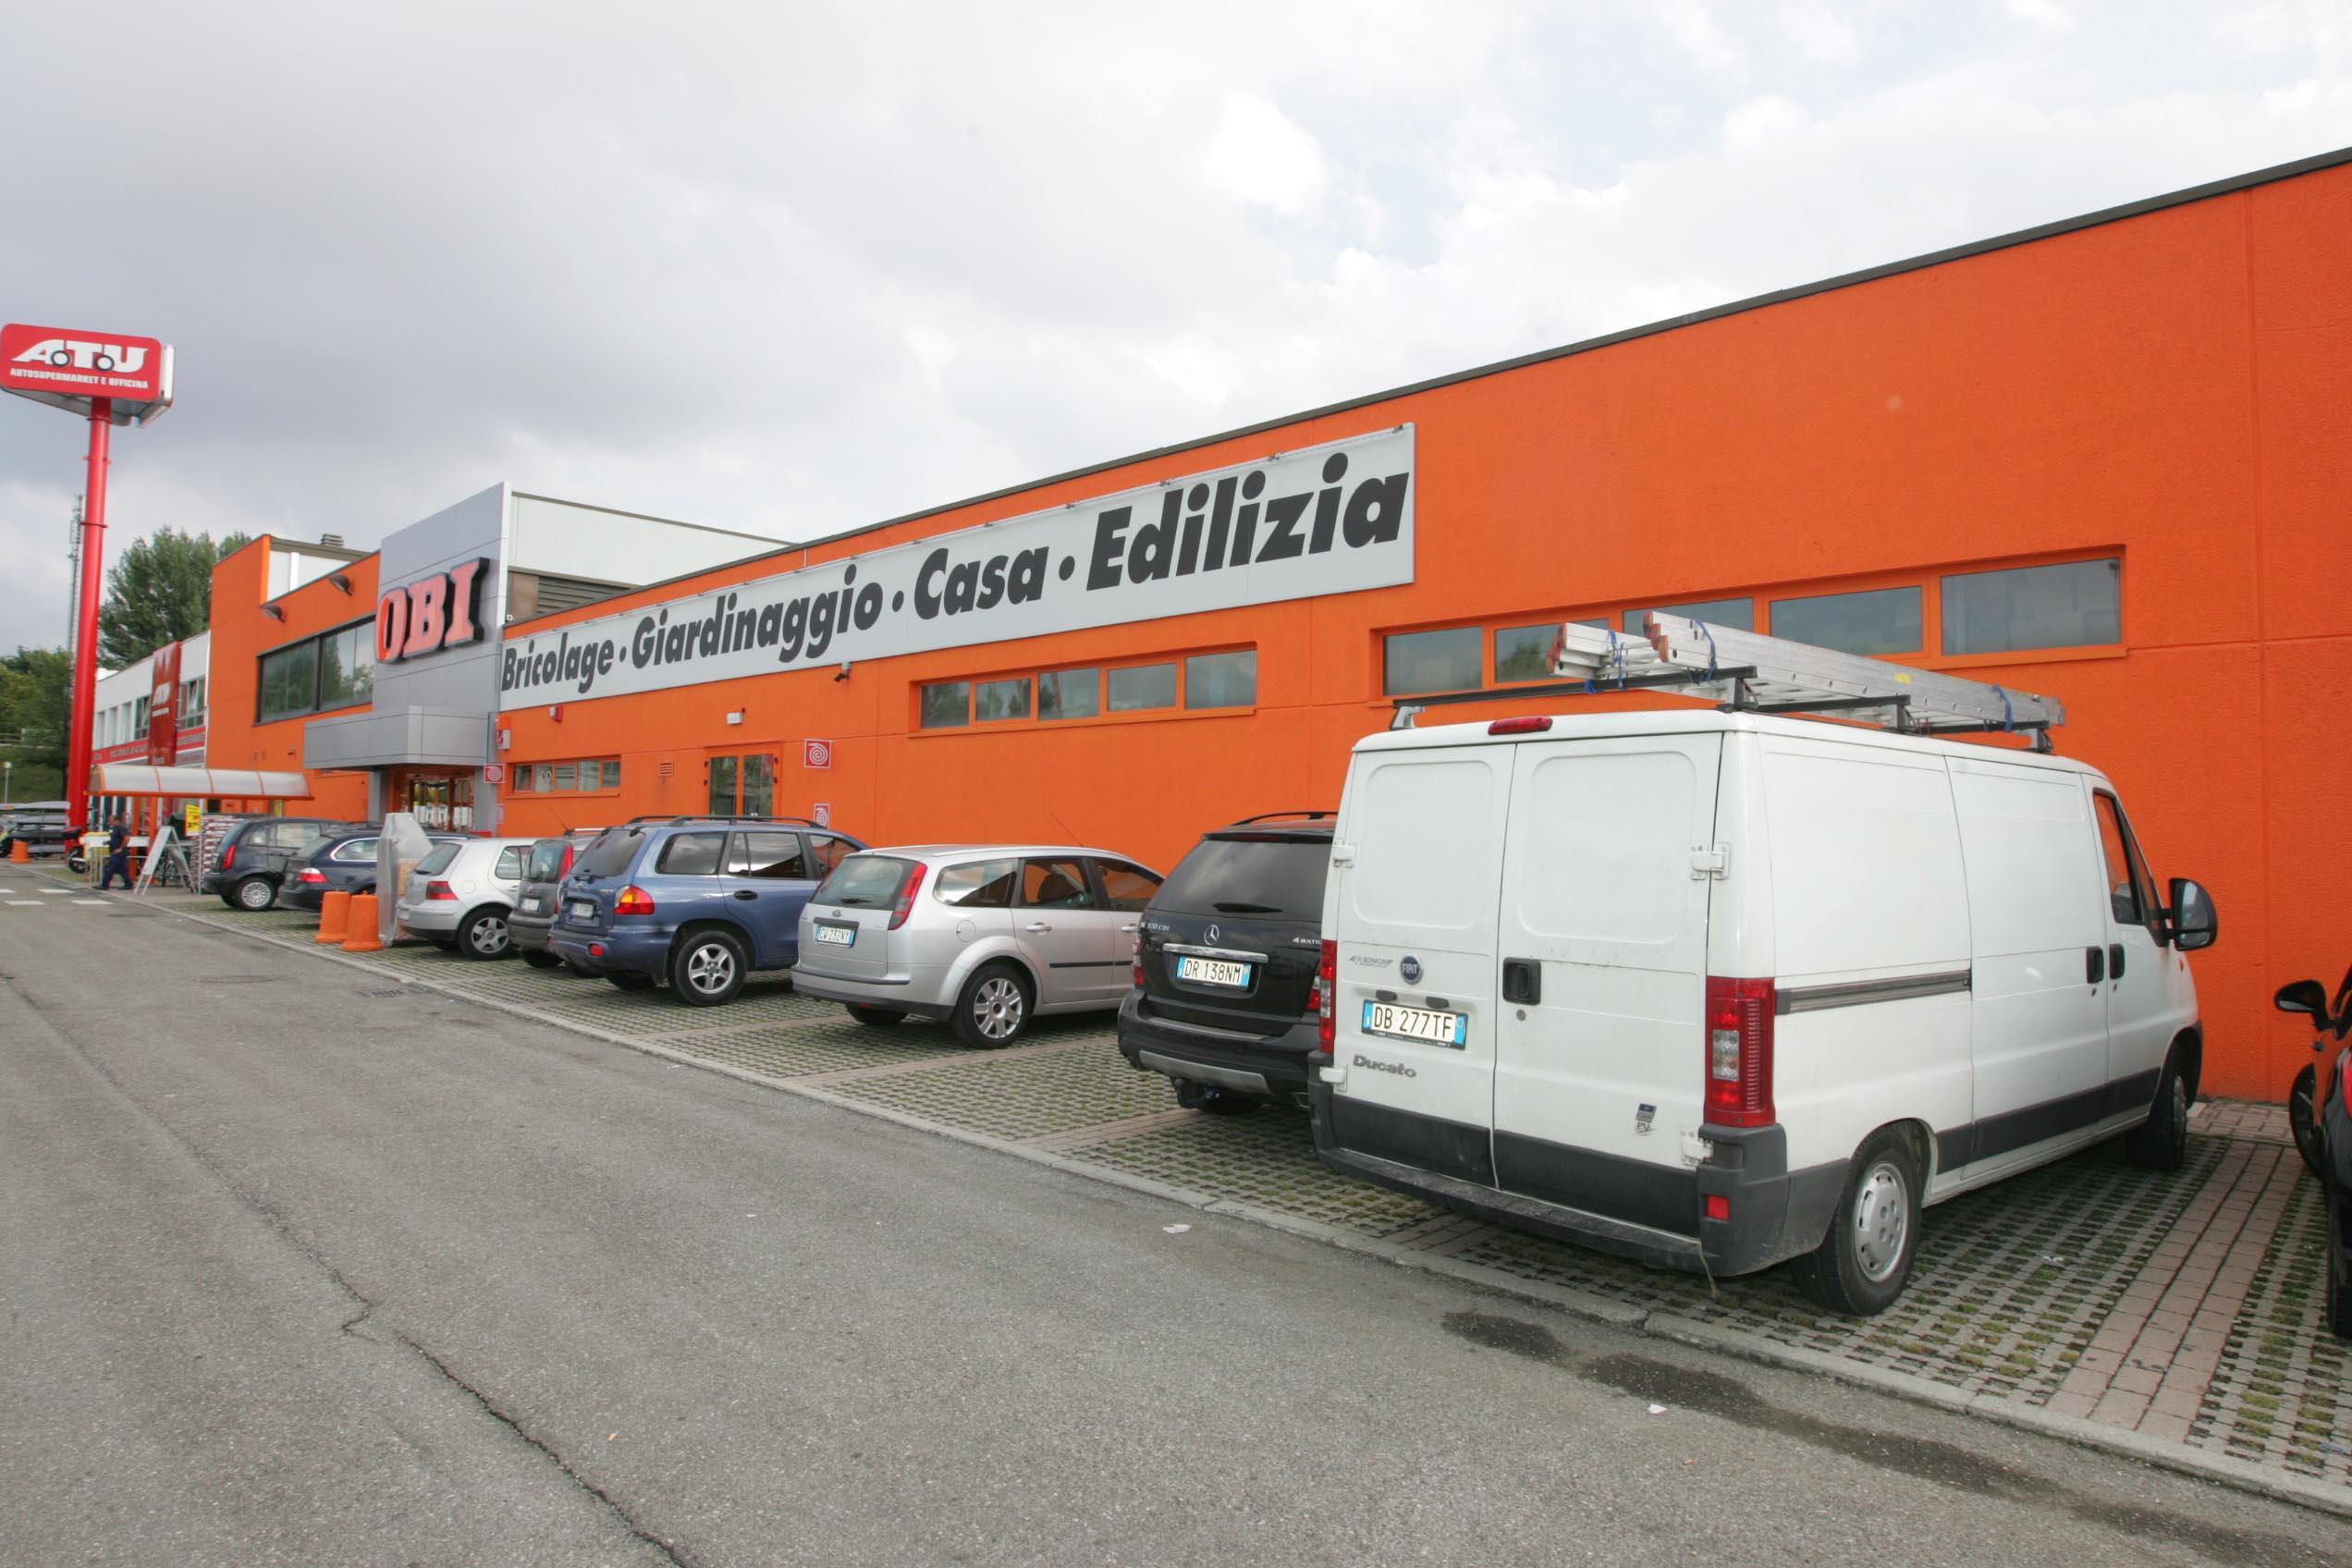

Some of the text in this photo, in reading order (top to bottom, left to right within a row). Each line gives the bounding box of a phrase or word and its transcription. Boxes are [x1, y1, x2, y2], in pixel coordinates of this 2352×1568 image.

[11, 338, 148, 373] ATU
[10, 368, 148, 389] AUTOSUPERMARKET E OFFICINA
[501, 452, 1410, 693] Bricolage Giardinaggio Casa Edilizia
[374, 557, 488, 665] OBI
[1184, 960, 1241, 984] DR 138NM
[1403, 963, 1418, 975] FIAT
[1374, 1006, 1452, 1038] DB 277TF
[1353, 1054, 1417, 1078] Ducato
